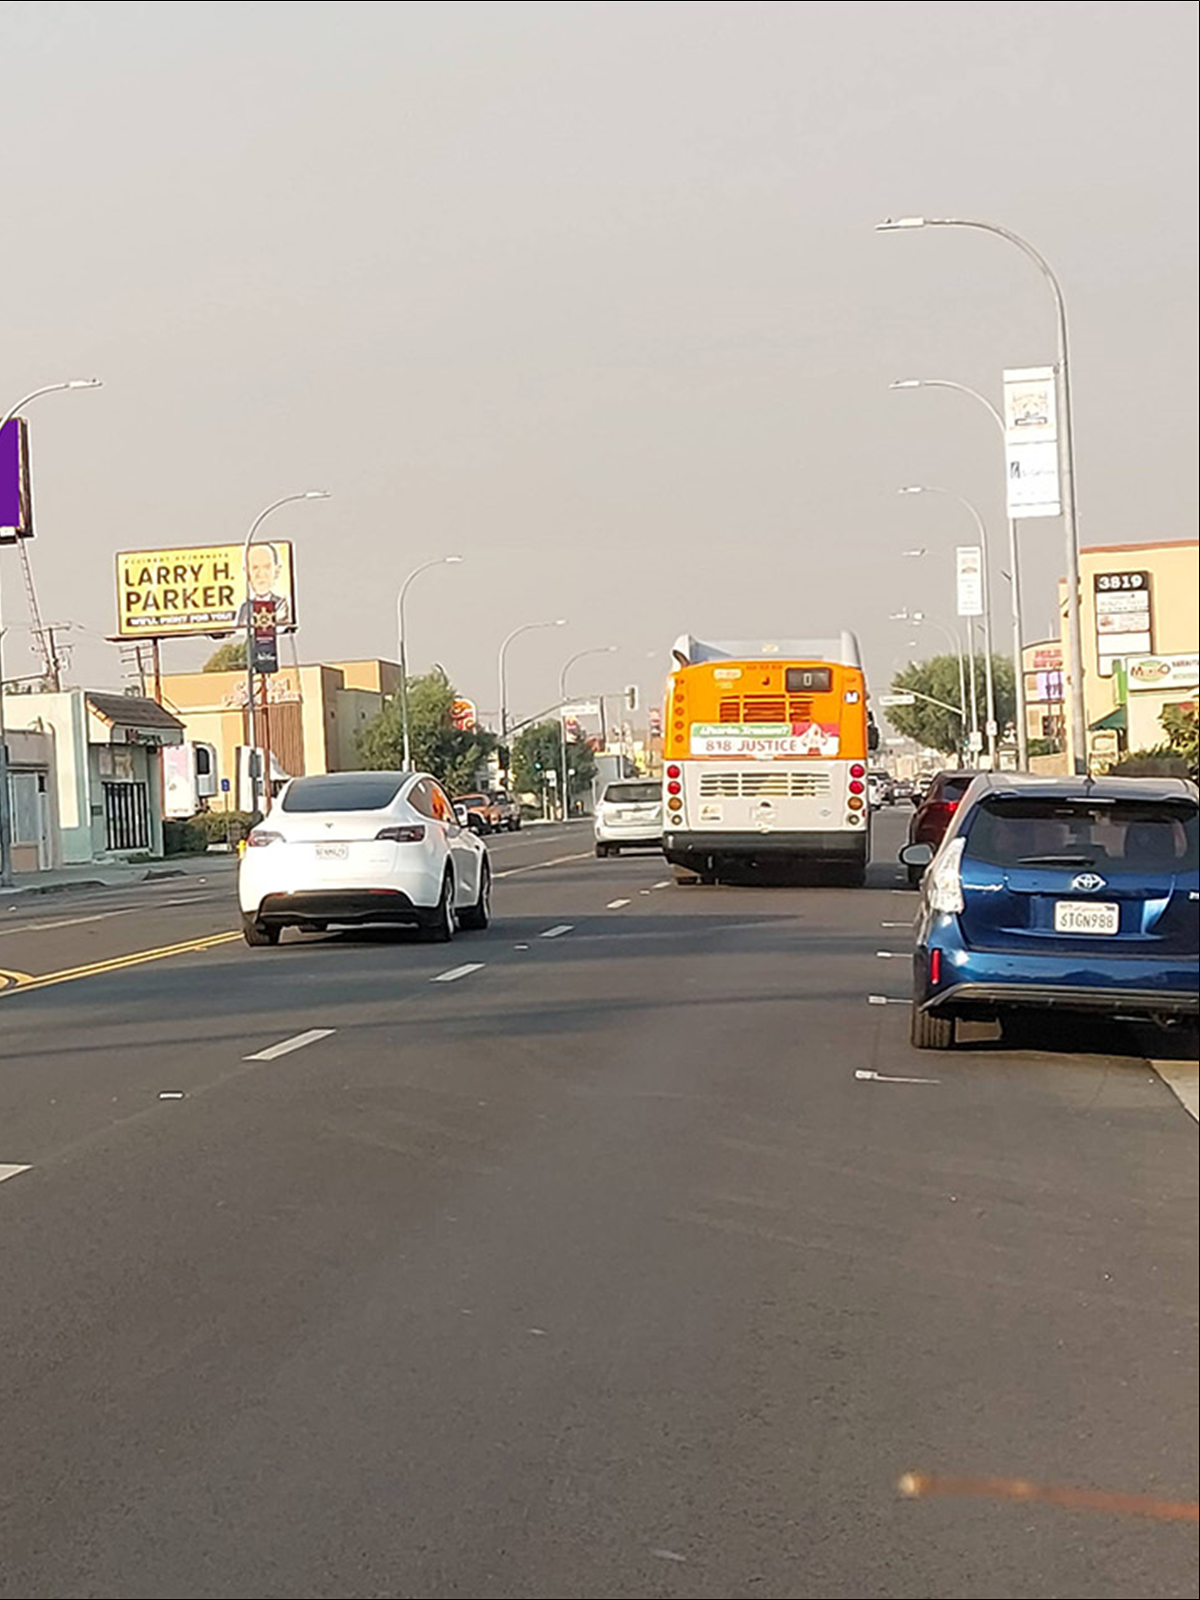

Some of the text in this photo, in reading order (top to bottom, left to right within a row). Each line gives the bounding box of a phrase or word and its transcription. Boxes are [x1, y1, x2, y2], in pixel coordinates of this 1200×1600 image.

[124, 562, 235, 587] LARRY H.
[1098, 574, 1143, 589] 3819
[125, 585, 235, 613] PARKER
[705, 739, 797, 752] 818 JUSTICE
